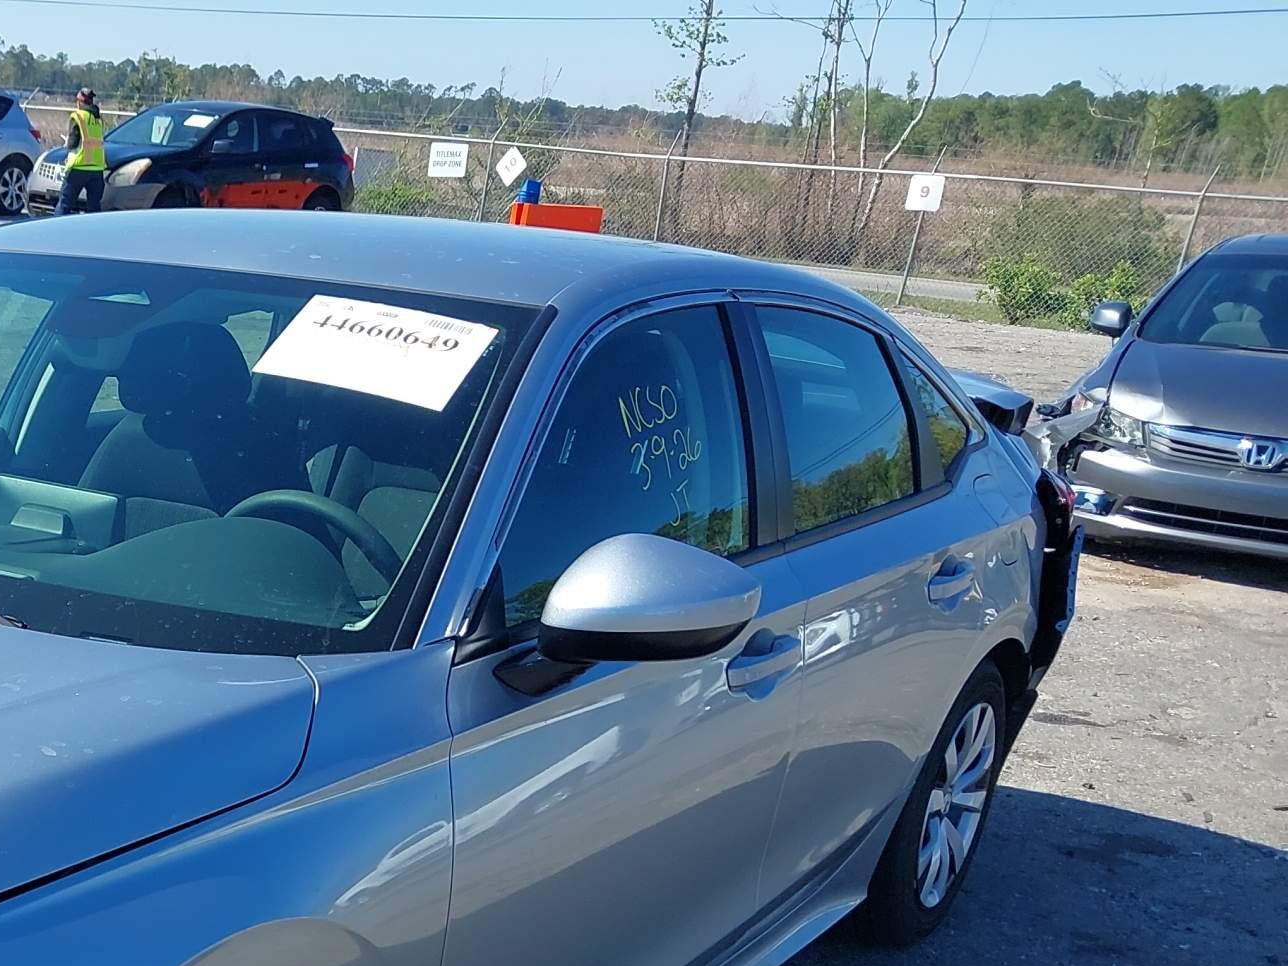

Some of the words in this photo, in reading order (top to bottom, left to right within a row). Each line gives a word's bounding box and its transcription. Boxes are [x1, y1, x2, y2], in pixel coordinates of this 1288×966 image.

[435, 150, 462, 158] TITLEMAX
[432, 160, 447, 168] DROP
[448, 160, 462, 168] ZONE
[504, 156, 518, 172] 10
[920, 185, 931, 198] 9
[312, 314, 460, 352] 44660649
[618, 385, 678, 439] NCSO
